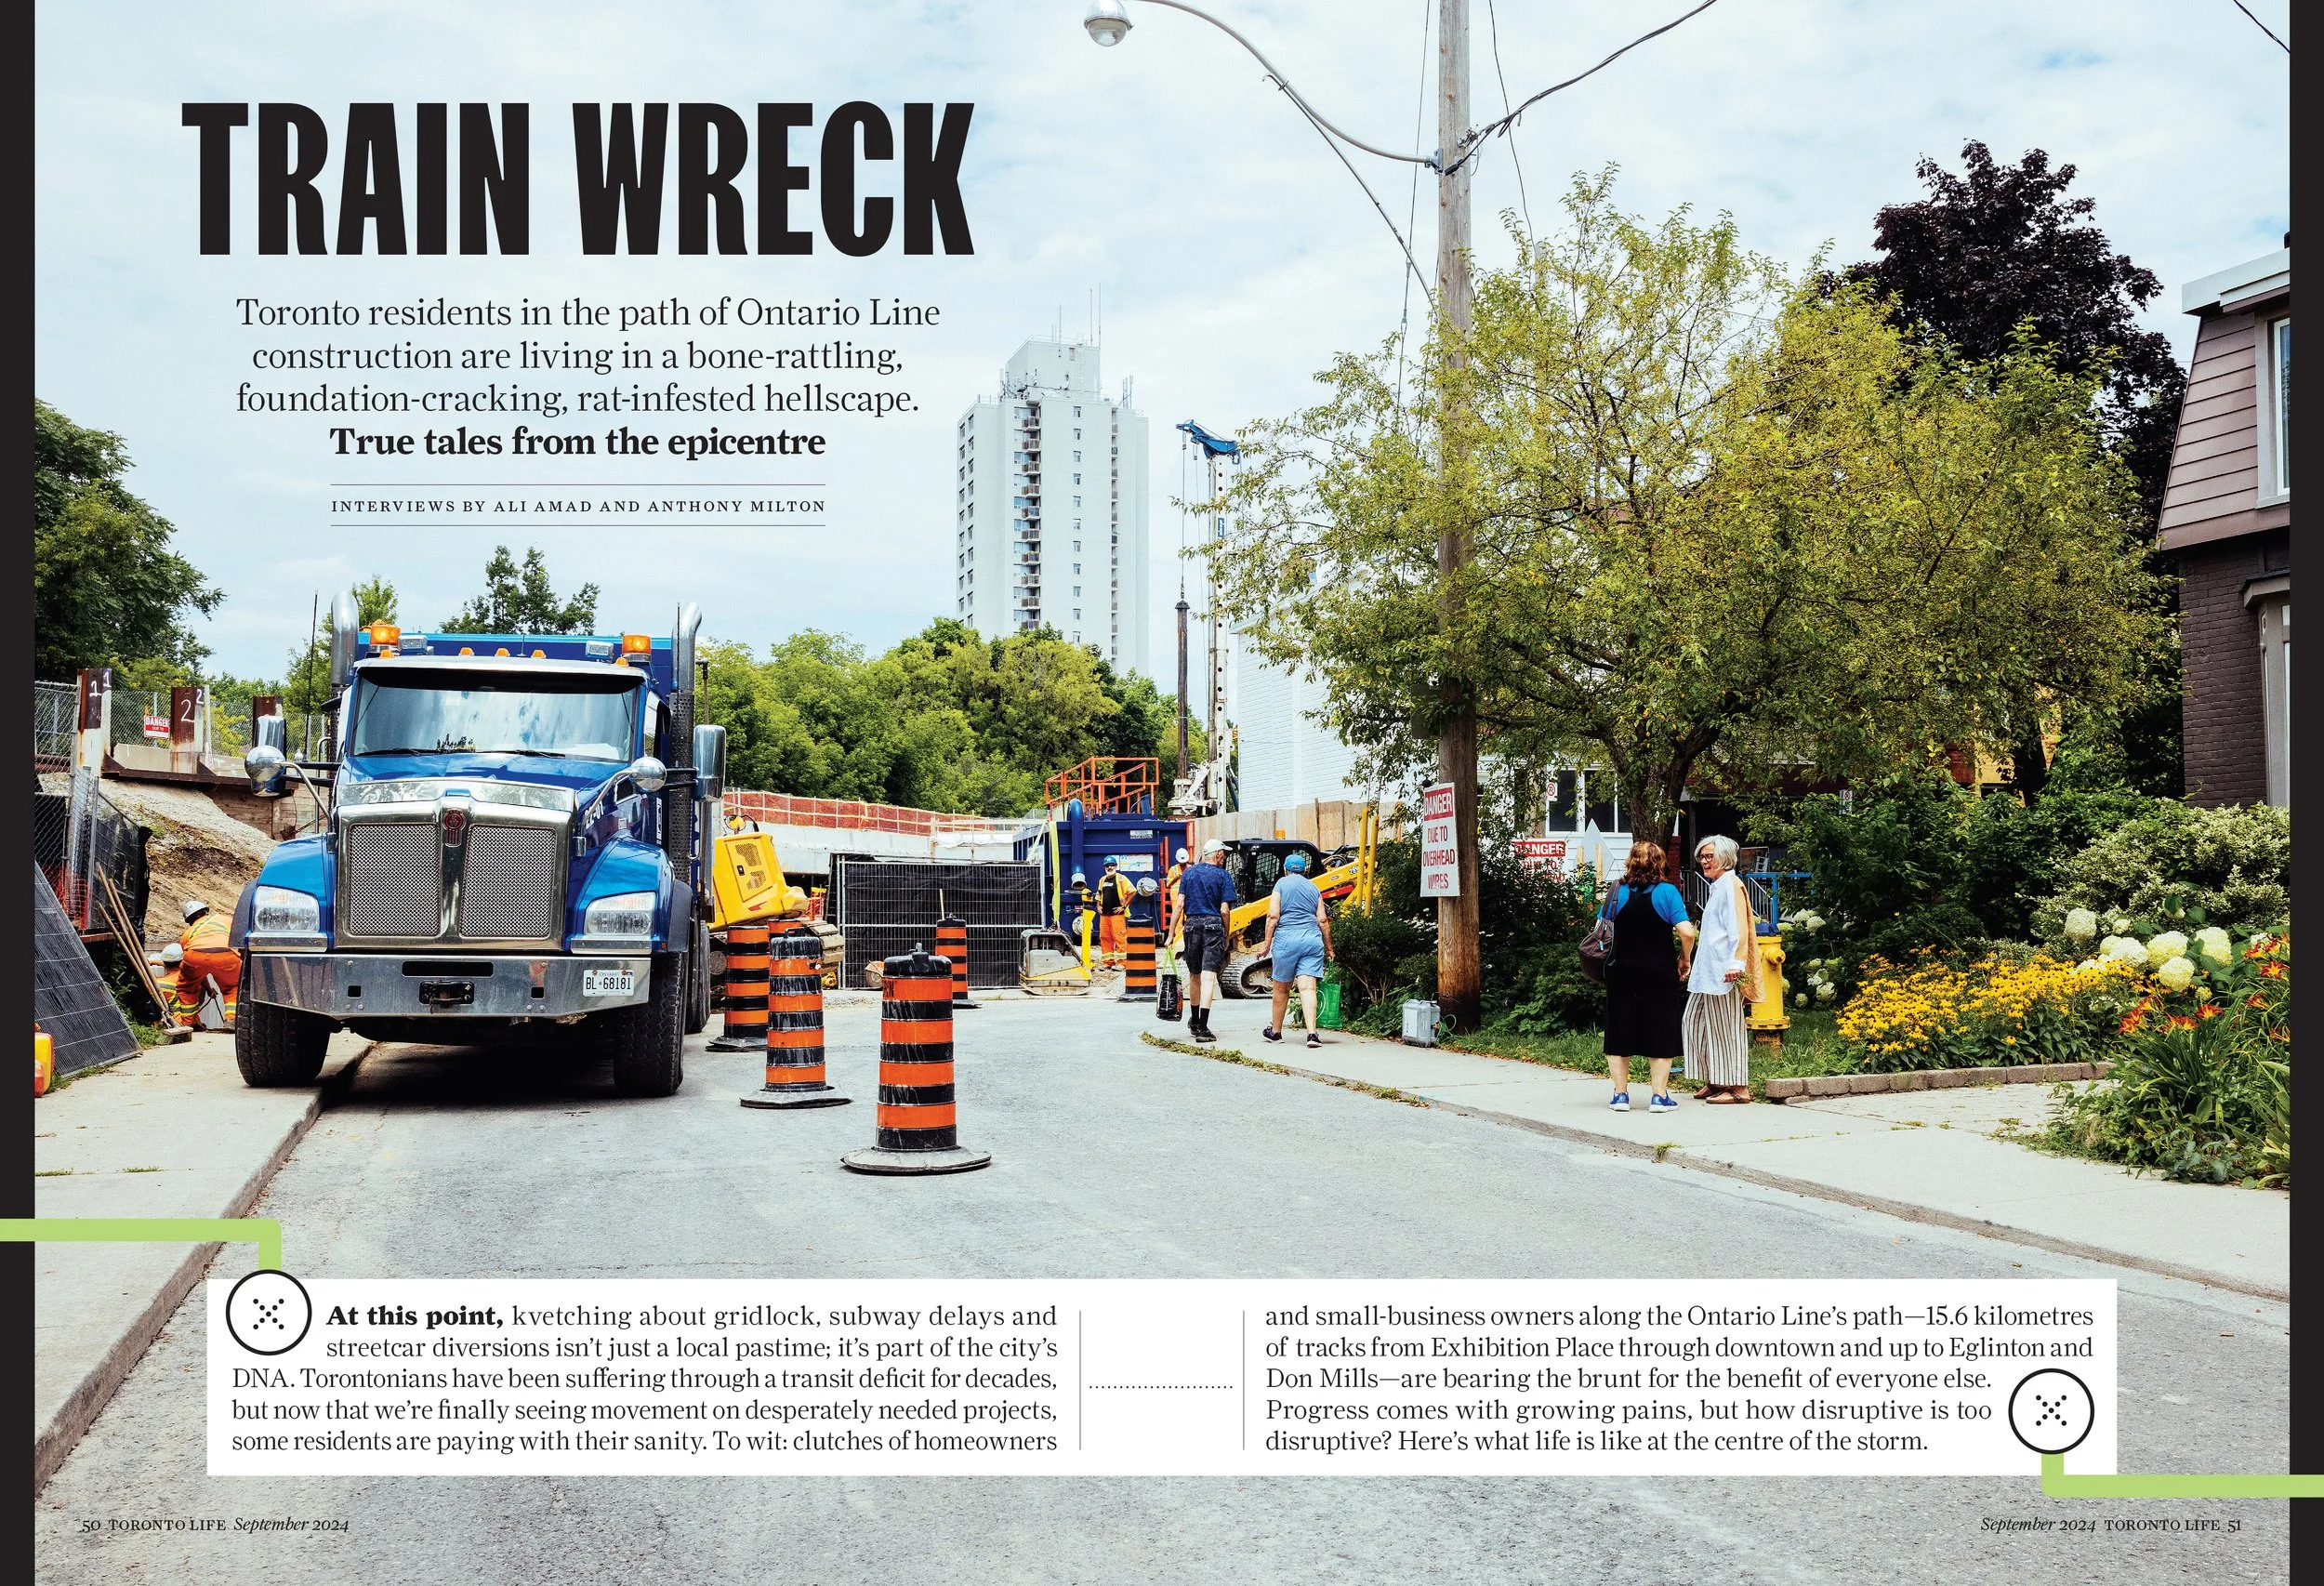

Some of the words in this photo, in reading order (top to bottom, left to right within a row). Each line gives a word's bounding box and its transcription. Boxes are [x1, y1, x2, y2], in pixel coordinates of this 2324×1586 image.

[180, 699, 195, 723] 2
[1424, 792, 1453, 816] DANGER
[1428, 826, 1439, 843] DUE
[1440, 825, 1447, 841] TO
[1422, 848, 1456, 866] OVERHEAD
[1427, 873, 1449, 890] WIRES
